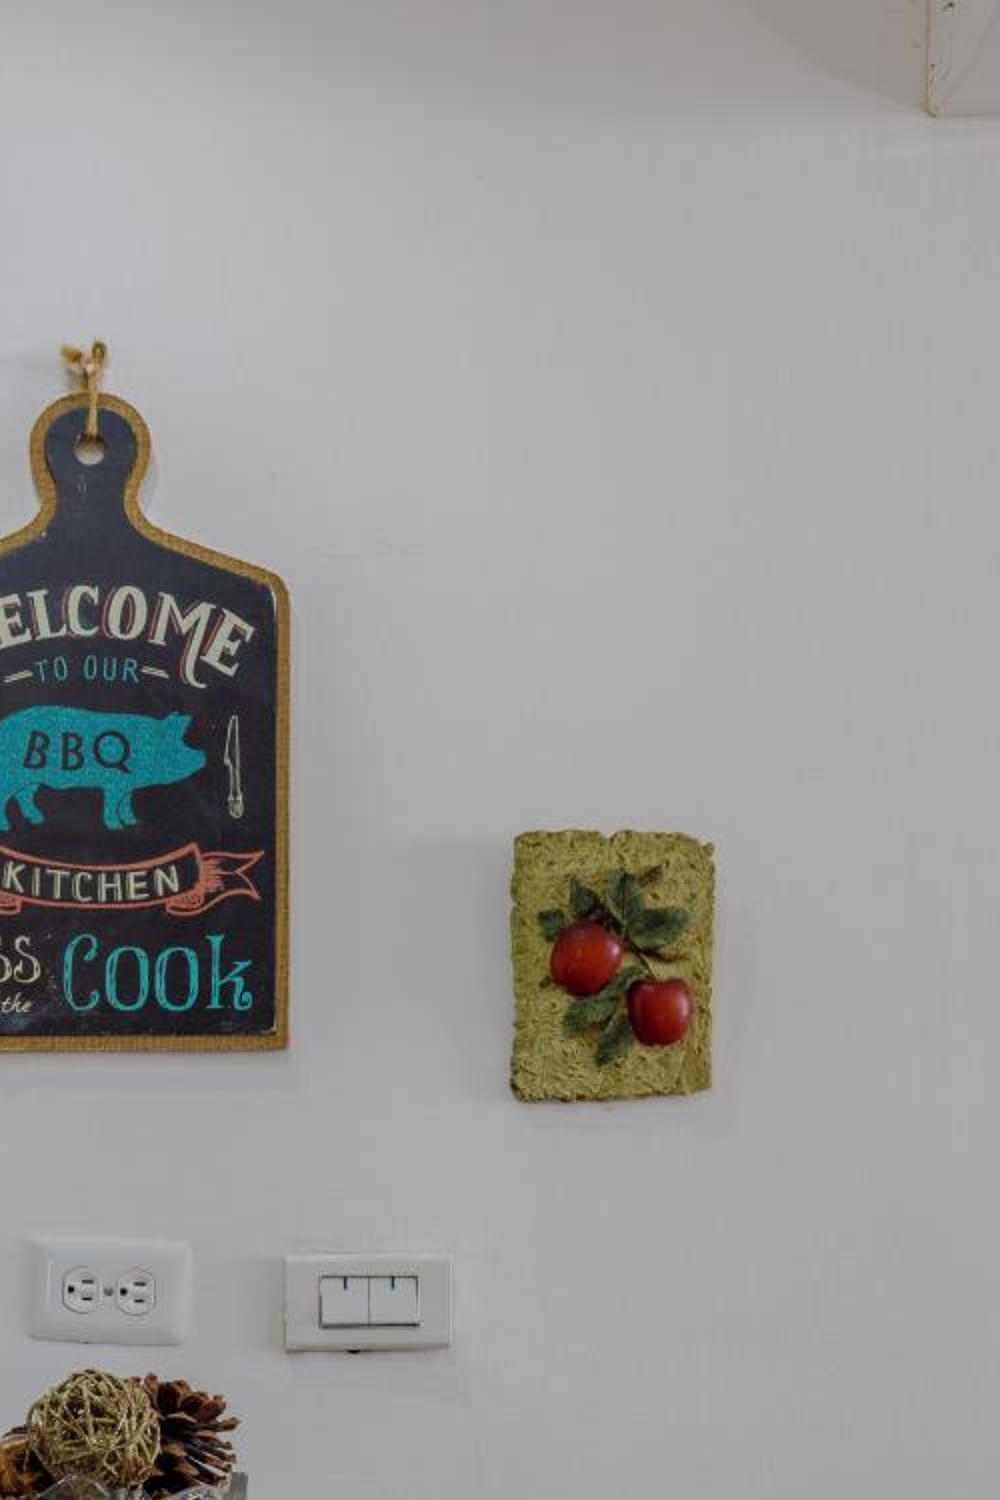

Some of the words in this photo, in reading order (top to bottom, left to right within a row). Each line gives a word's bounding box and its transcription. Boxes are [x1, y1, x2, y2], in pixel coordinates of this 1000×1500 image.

[36, 658, 68, 683] TO
[84, 656, 139, 683] OUR
[23, 731, 131, 774] BBQ
[2, 861, 180, 902] KITCHEN
[1, 992, 33, 1013] the
